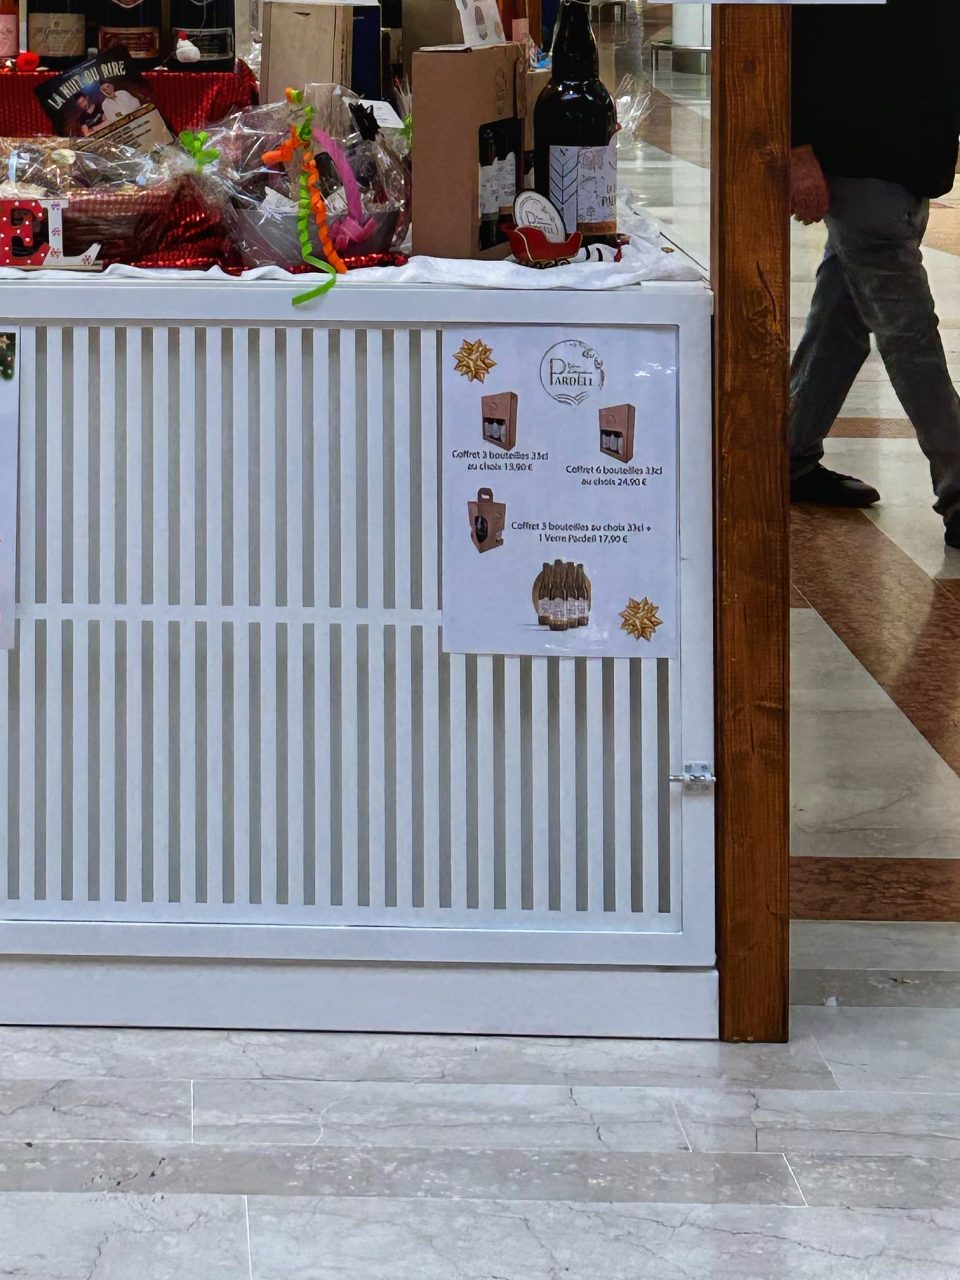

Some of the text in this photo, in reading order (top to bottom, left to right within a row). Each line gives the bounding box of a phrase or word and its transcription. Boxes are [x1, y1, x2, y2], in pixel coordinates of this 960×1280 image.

[48, 60, 126, 110] LA NUIT DU RIRE
[451, 449, 480, 459] Coffret
[488, 450, 530, 460] bouteilles
[565, 465, 594, 474] Coffret
[602, 465, 644, 475] bouteilles
[511, 521, 540, 531] Coffret
[541, 522, 547, 531] 3
[548, 521, 589, 532] bouteilles
[603, 522, 626, 532] choix
